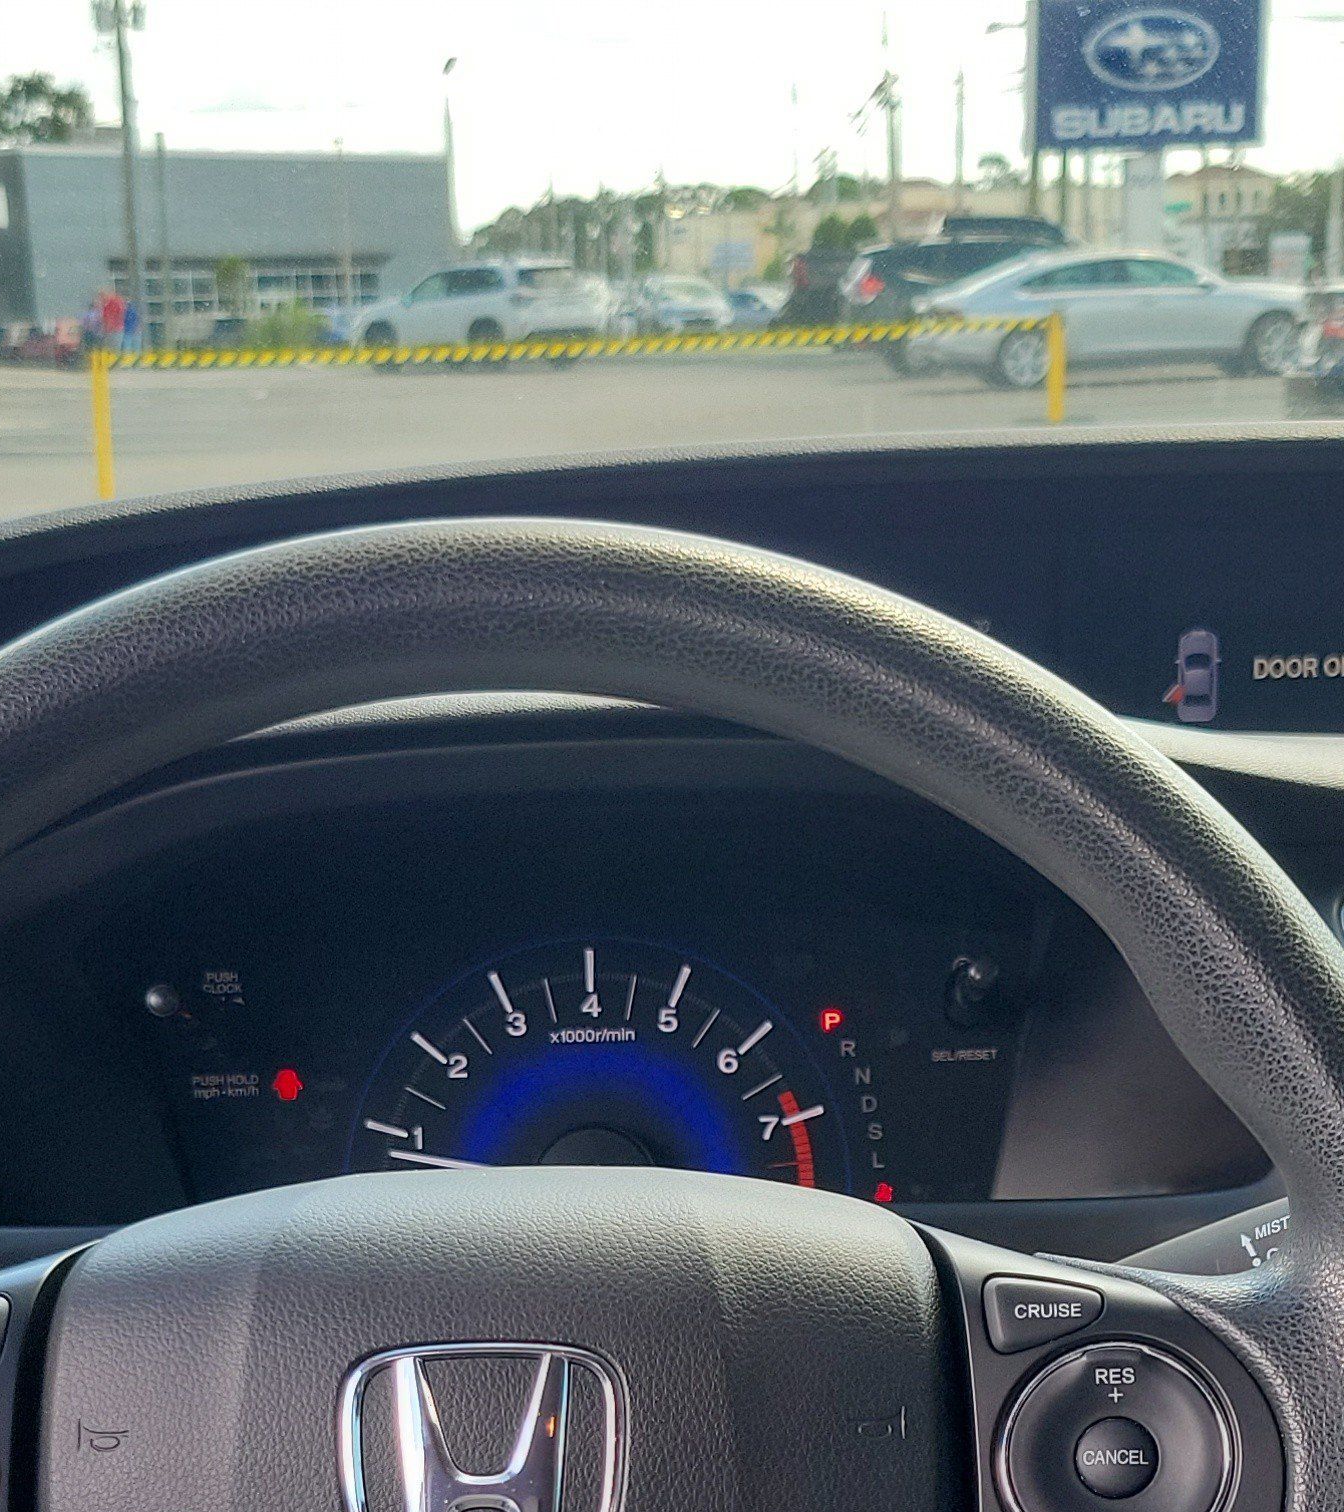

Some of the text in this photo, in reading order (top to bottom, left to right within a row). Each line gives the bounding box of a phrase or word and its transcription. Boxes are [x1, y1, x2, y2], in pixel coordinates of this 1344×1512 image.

[1053, 102, 1246, 140] SUBARU
[1253, 656, 1318, 680] DOOR
[205, 971, 239, 983] PUSH
[581, 995, 602, 1019] 4
[506, 1013, 528, 1037] 3
[658, 1009, 679, 1033] 5
[824, 1012, 842, 1031] P
[840, 1040, 856, 1058] R
[447, 1056, 468, 1079] 2
[717, 1050, 739, 1074] 6
[854, 1067, 871, 1086] N
[860, 1096, 878, 1114] D
[412, 1127, 424, 1150] 1
[758, 1116, 781, 1141] 7
[868, 1123, 884, 1141] S
[872, 1152, 885, 1170] L
[1254, 1214, 1292, 1240] MIST
[1014, 1302, 1082, 1319] CRUISE
[1095, 1367, 1136, 1385] RES
[1082, 1449, 1149, 1466] CANCEL
